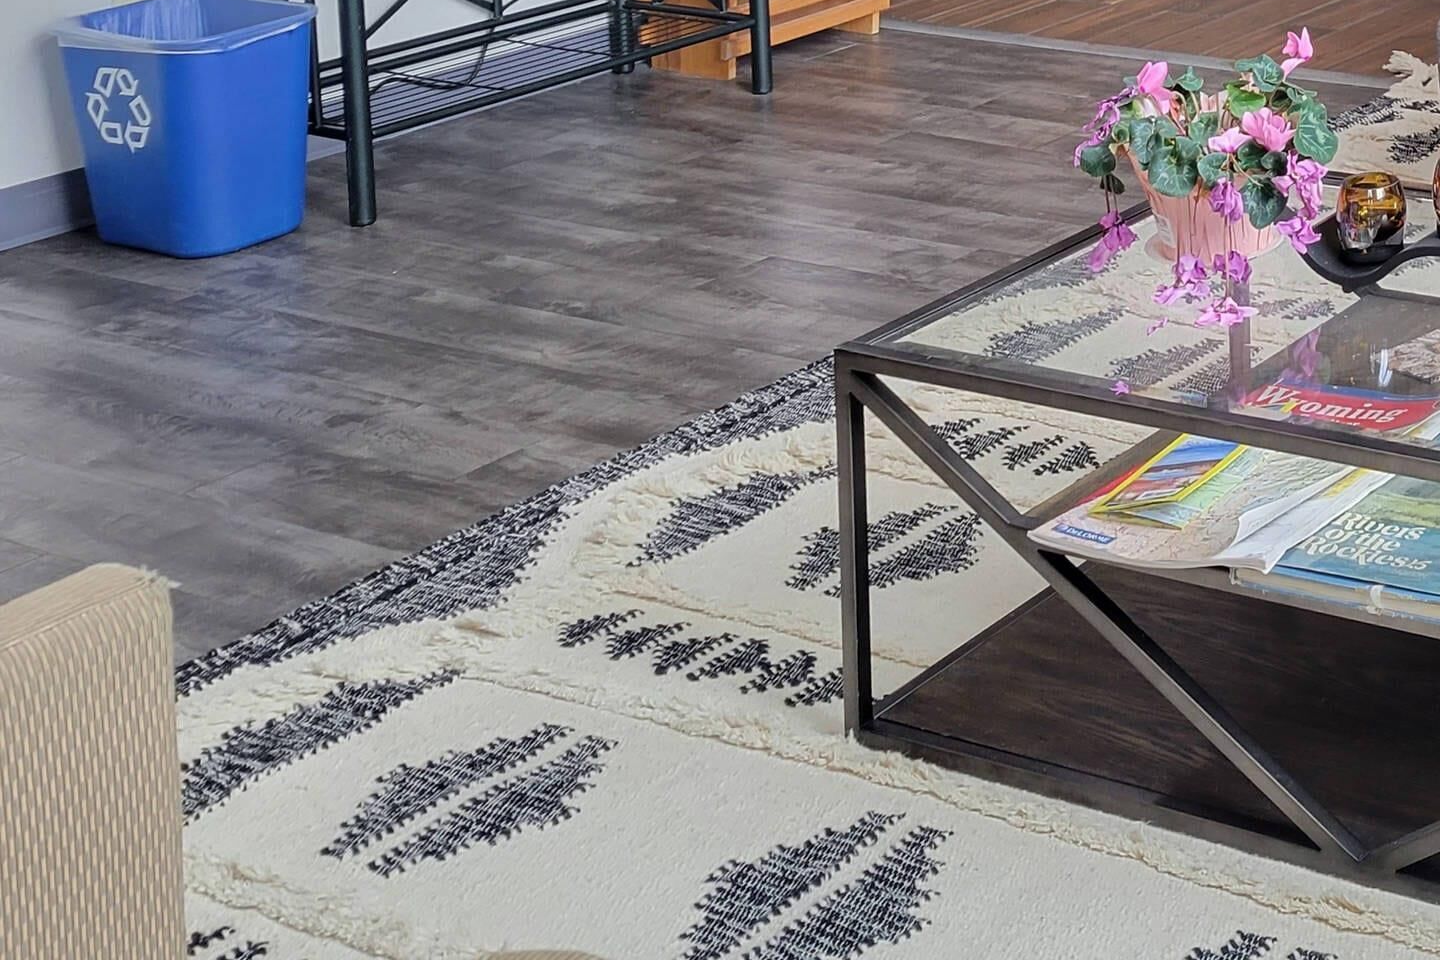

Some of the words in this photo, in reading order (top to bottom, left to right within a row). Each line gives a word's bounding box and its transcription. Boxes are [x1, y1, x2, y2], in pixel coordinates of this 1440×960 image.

[1257, 383, 1408, 423] Wyoming
[1332, 512, 1426, 540] Rivers
[1355, 531, 1401, 551] the
